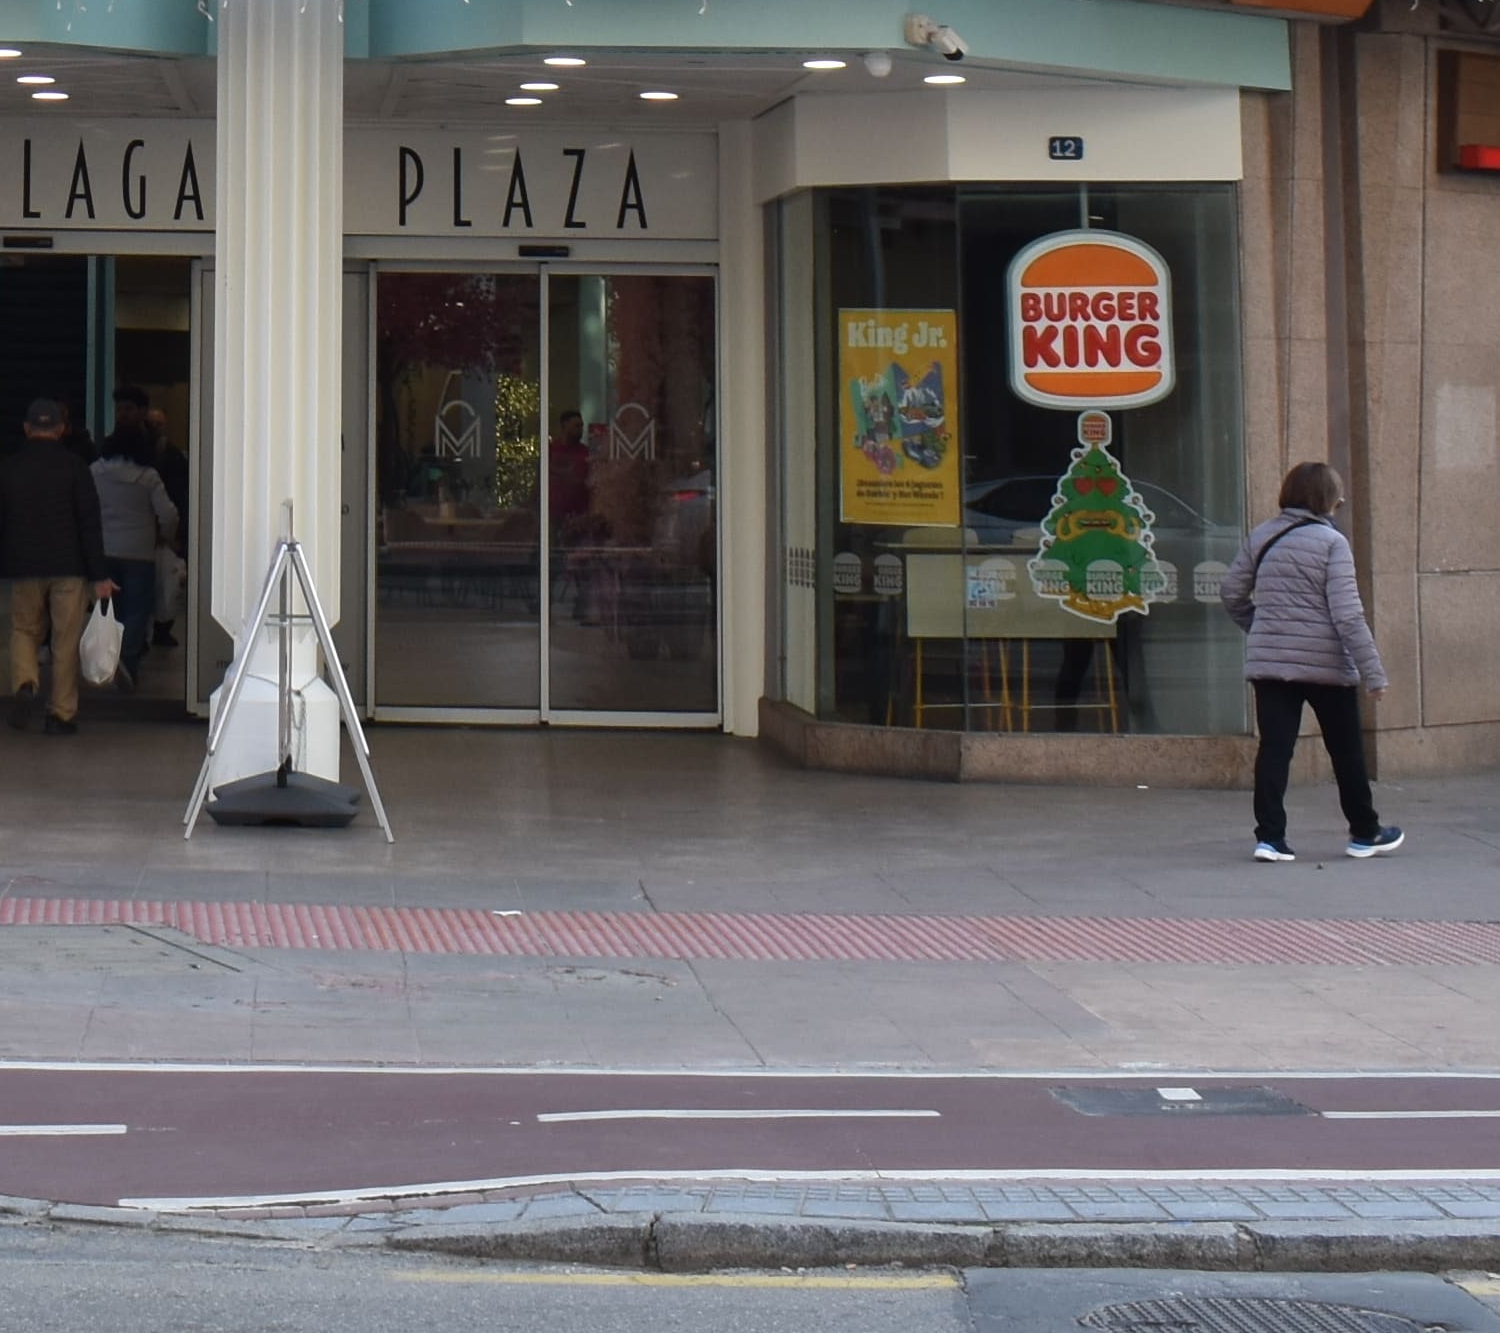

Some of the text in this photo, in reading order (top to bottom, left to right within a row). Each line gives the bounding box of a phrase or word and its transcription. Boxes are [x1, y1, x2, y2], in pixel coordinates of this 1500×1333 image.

[1052, 140, 1076, 157] 12
[399, 145, 649, 230] PLAZA
[1021, 292, 1160, 322] BURGER
[848, 319, 947, 355] King Jr.
[1022, 324, 1162, 368] KING
[1195, 581, 1221, 594] KIN
